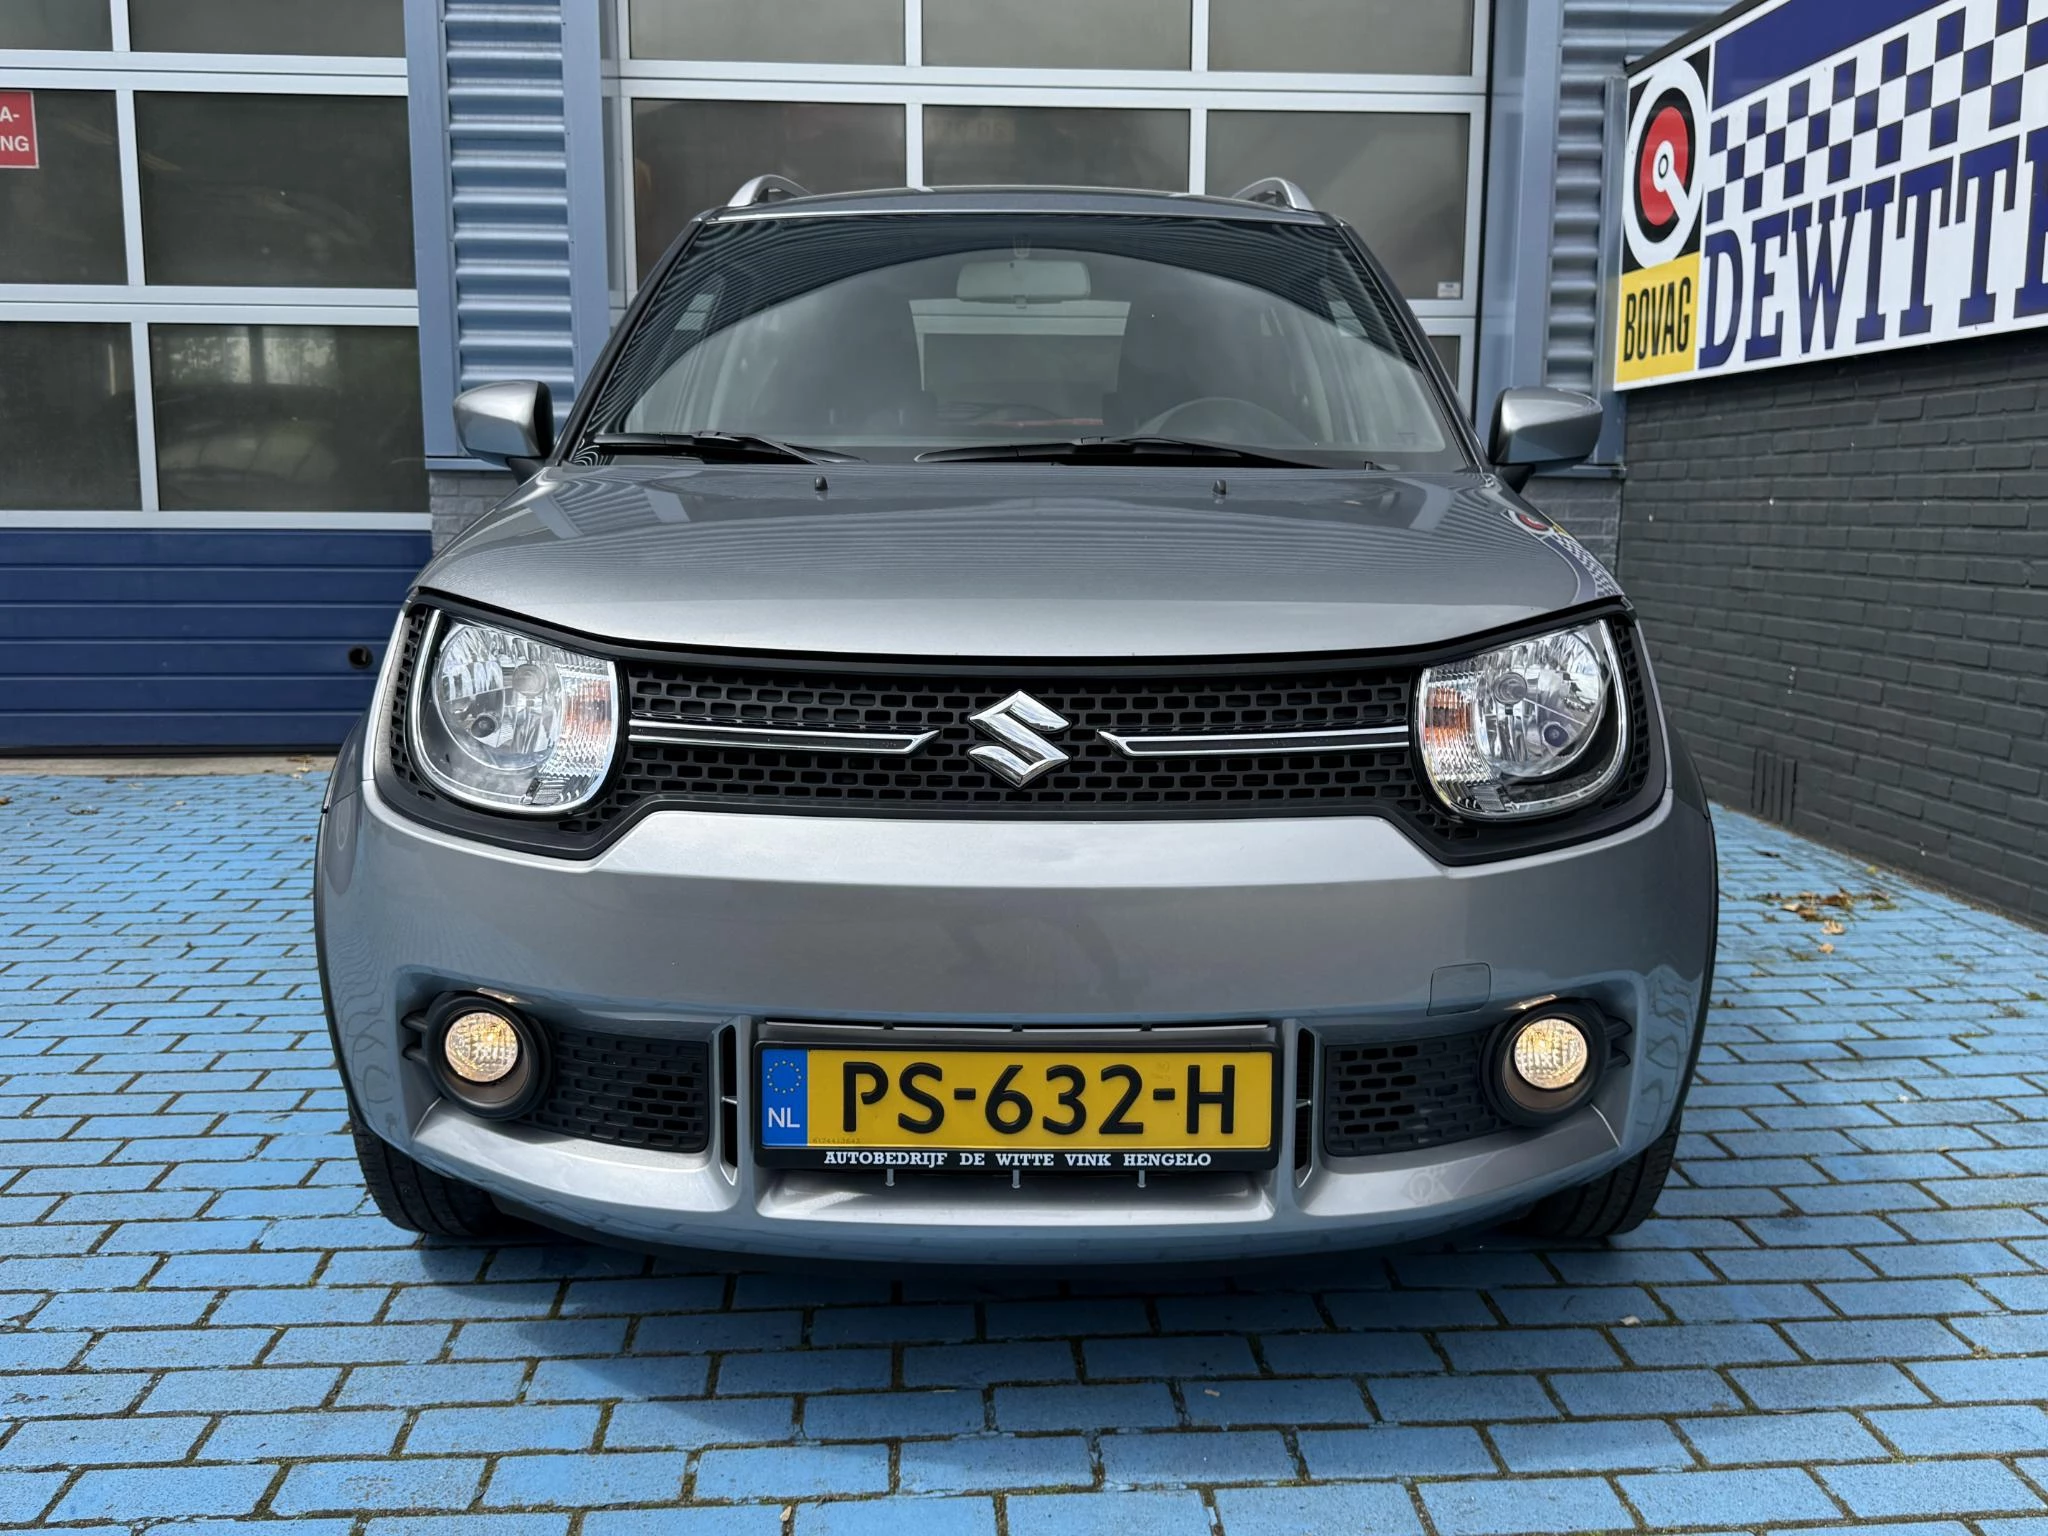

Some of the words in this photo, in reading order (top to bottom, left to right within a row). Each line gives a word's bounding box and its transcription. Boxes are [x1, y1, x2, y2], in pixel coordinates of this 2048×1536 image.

[1623, 276, 1691, 362] BOVAG
[767, 1107, 800, 1129] NL
[842, 1061, 1236, 1135] PS-632-H
[824, 1151, 948, 1167] AUTOBEDRIJF
[959, 1152, 985, 1167] DE
[995, 1152, 1055, 1167] WITTE
[1065, 1152, 1112, 1167] VINK
[1123, 1152, 1213, 1168] HENGELO
